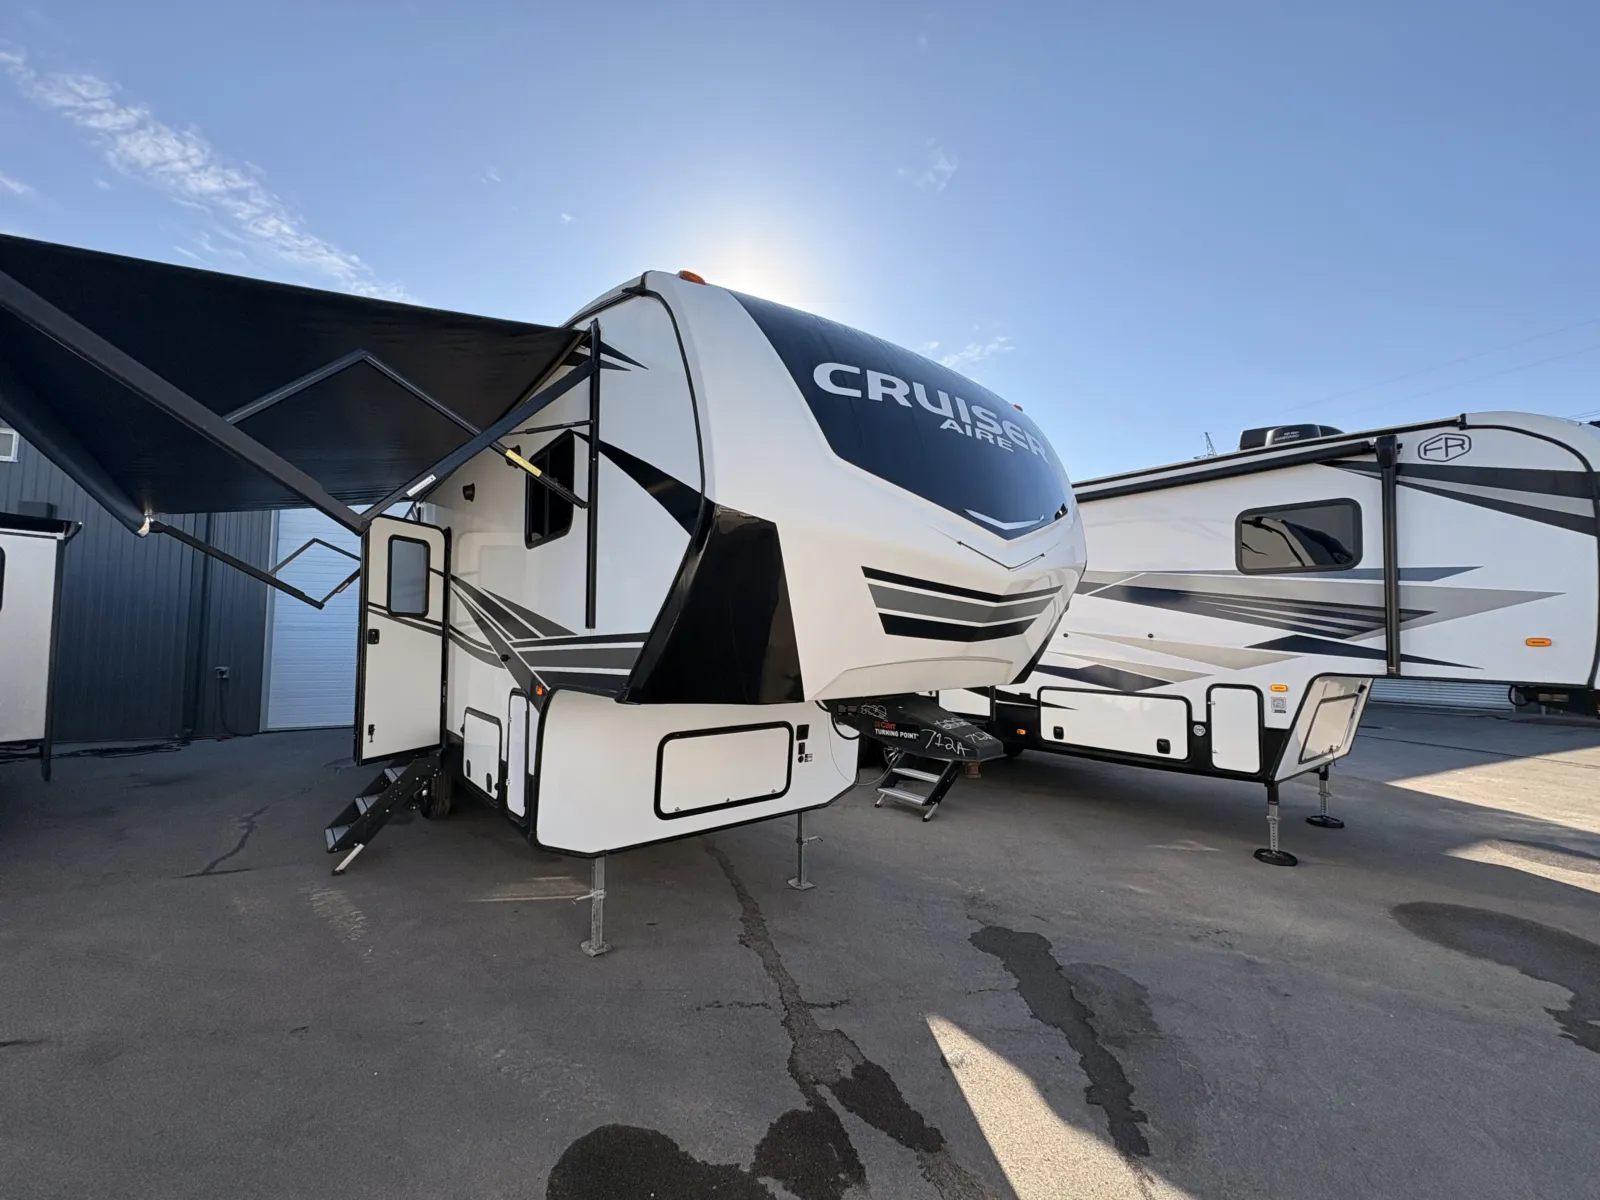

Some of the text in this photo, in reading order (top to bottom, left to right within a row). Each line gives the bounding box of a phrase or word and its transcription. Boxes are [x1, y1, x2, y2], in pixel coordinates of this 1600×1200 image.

[813, 362, 1049, 463] CRUISER
[940, 418, 1014, 452] AIRE
[1424, 437, 1465, 458] FR
[875, 728, 899, 737] TURNING
[921, 728, 970, 757] 712A
